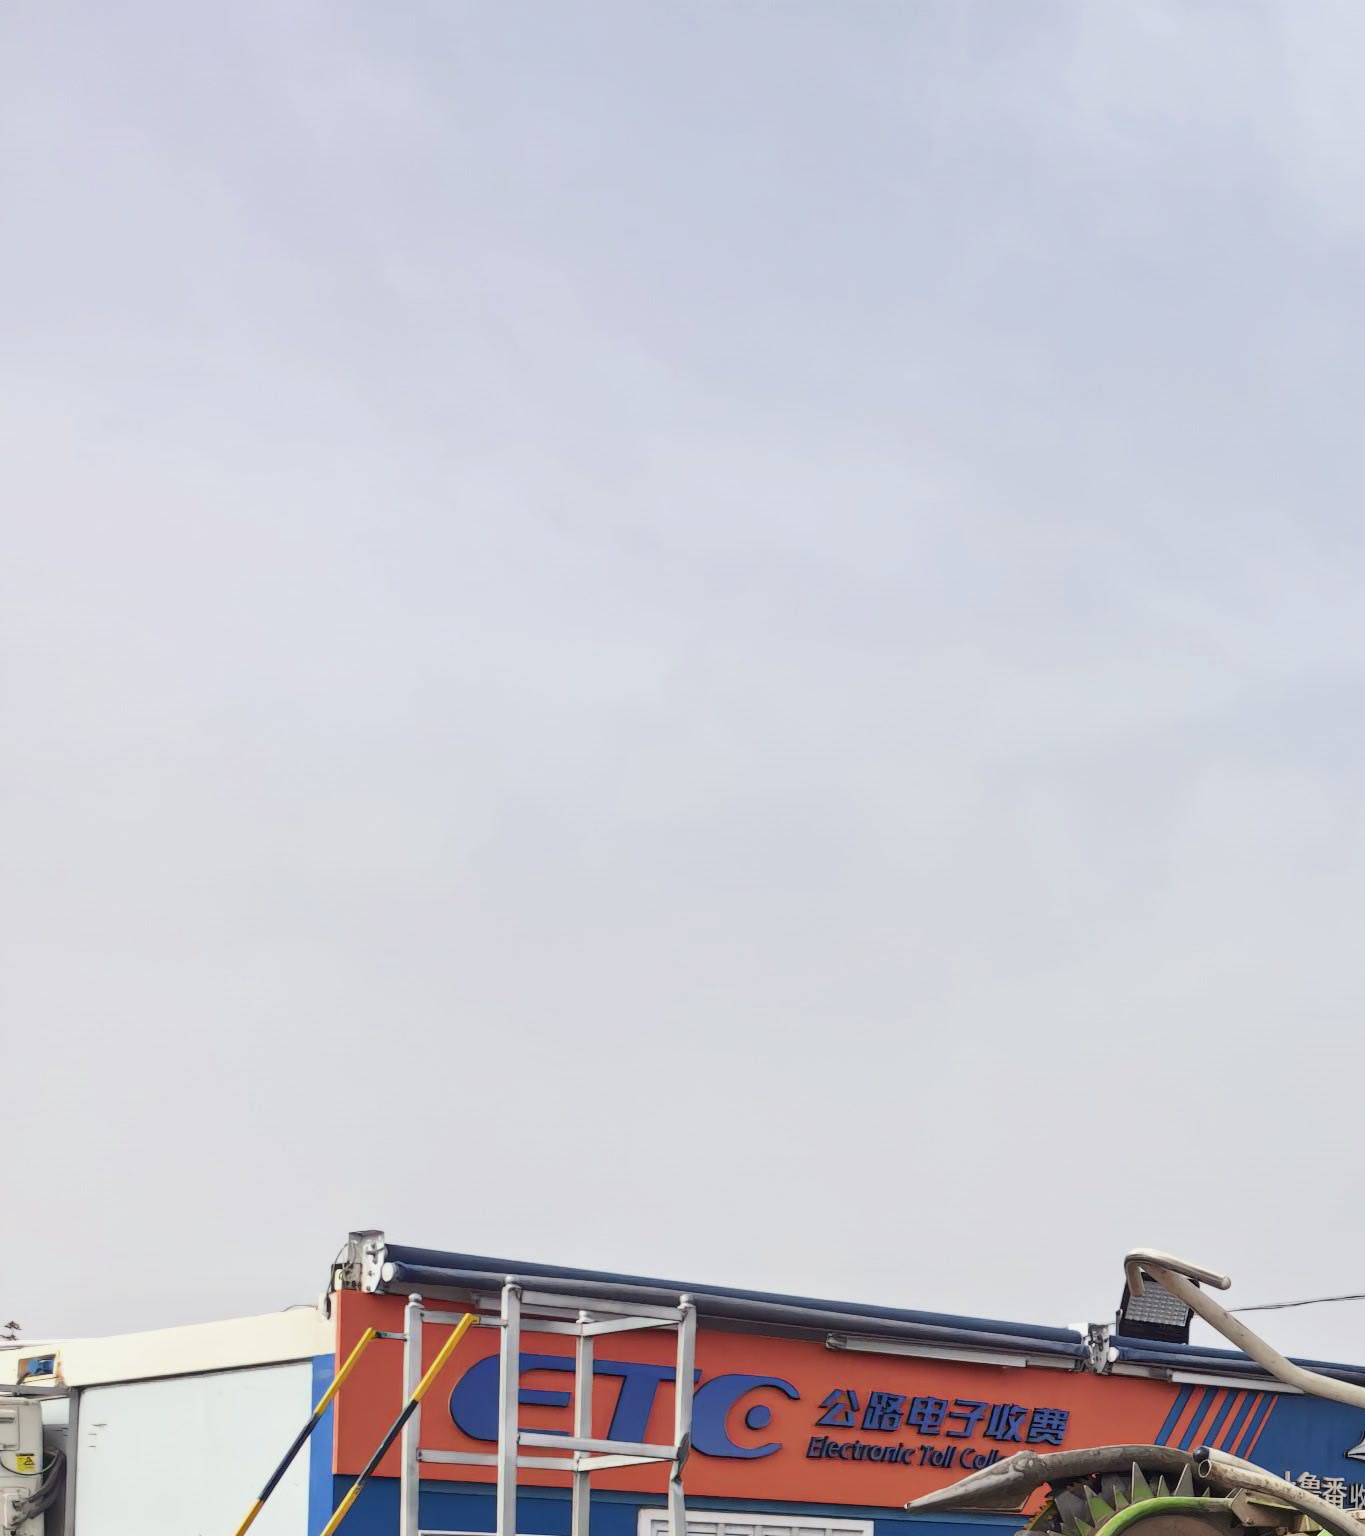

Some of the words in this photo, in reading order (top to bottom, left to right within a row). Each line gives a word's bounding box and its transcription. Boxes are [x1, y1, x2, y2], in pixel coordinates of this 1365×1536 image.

[449, 1352, 800, 1459] ETC
[815, 1388, 1070, 1446] 公路电子收费
[806, 1435, 914, 1466] Electronic
[918, 1443, 957, 1468] Toll
[959, 1447, 1009, 1470] Coll
